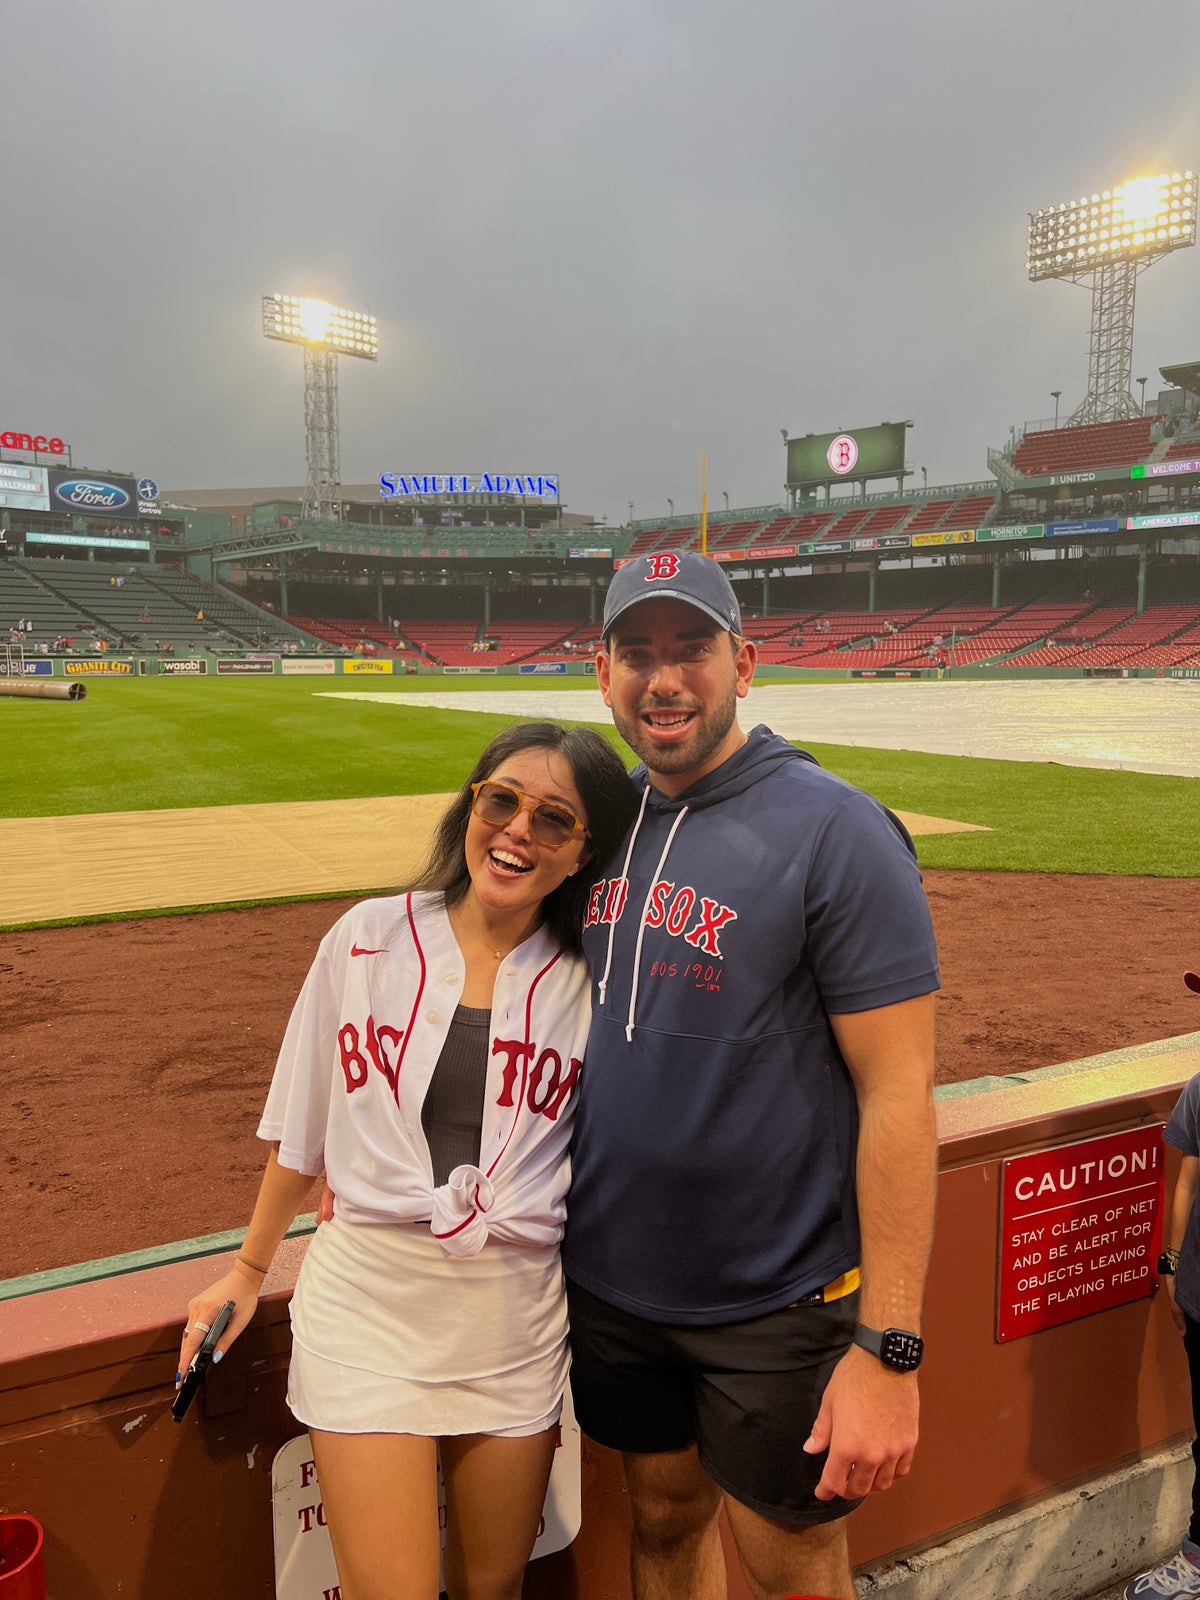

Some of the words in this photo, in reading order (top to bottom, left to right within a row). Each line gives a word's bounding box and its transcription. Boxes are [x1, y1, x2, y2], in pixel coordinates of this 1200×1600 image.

[1059, 472, 1096, 483] UNITED
[1152, 462, 1192, 474] WELCOME
[71, 483, 115, 506] Ford
[379, 471, 475, 498] SAMUEL
[477, 471, 558, 498] ADAMS
[991, 526, 1028, 537] HORNITOS
[1142, 517, 1177, 526] AMERICA'S
[644, 552, 681, 582] B
[66, 661, 109, 673] GRANITE
[110, 660, 132, 673] CITY
[164, 660, 200, 671] wasabi
[1171, 669, 1183, 678] JIM
[1185, 669, 1200, 678] BEA
[582, 876, 629, 935] ED
[644, 879, 738, 958] SOX
[650, 960, 678, 977] BOS
[683, 962, 724, 983] 1901
[1014, 1146, 1158, 1201] CAUTION!
[1011, 1227, 1046, 1247] STAY
[1051, 1213, 1099, 1237] CLEAR
[1104, 1206, 1125, 1222] OF
[1130, 1198, 1156, 1216] NET
[1012, 1251, 1043, 1271] AND
[1049, 1243, 1069, 1261] BE
[1074, 1230, 1120, 1253] ALERT
[1124, 1221, 1152, 1239] FOR
[1016, 1262, 1084, 1292] OBJECTS
[1090, 1244, 1147, 1271] LEAVING
[1011, 1297, 1041, 1316] THE
[1047, 1278, 1105, 1306] PLAYING
[1111, 1265, 1149, 1287] FIELD
